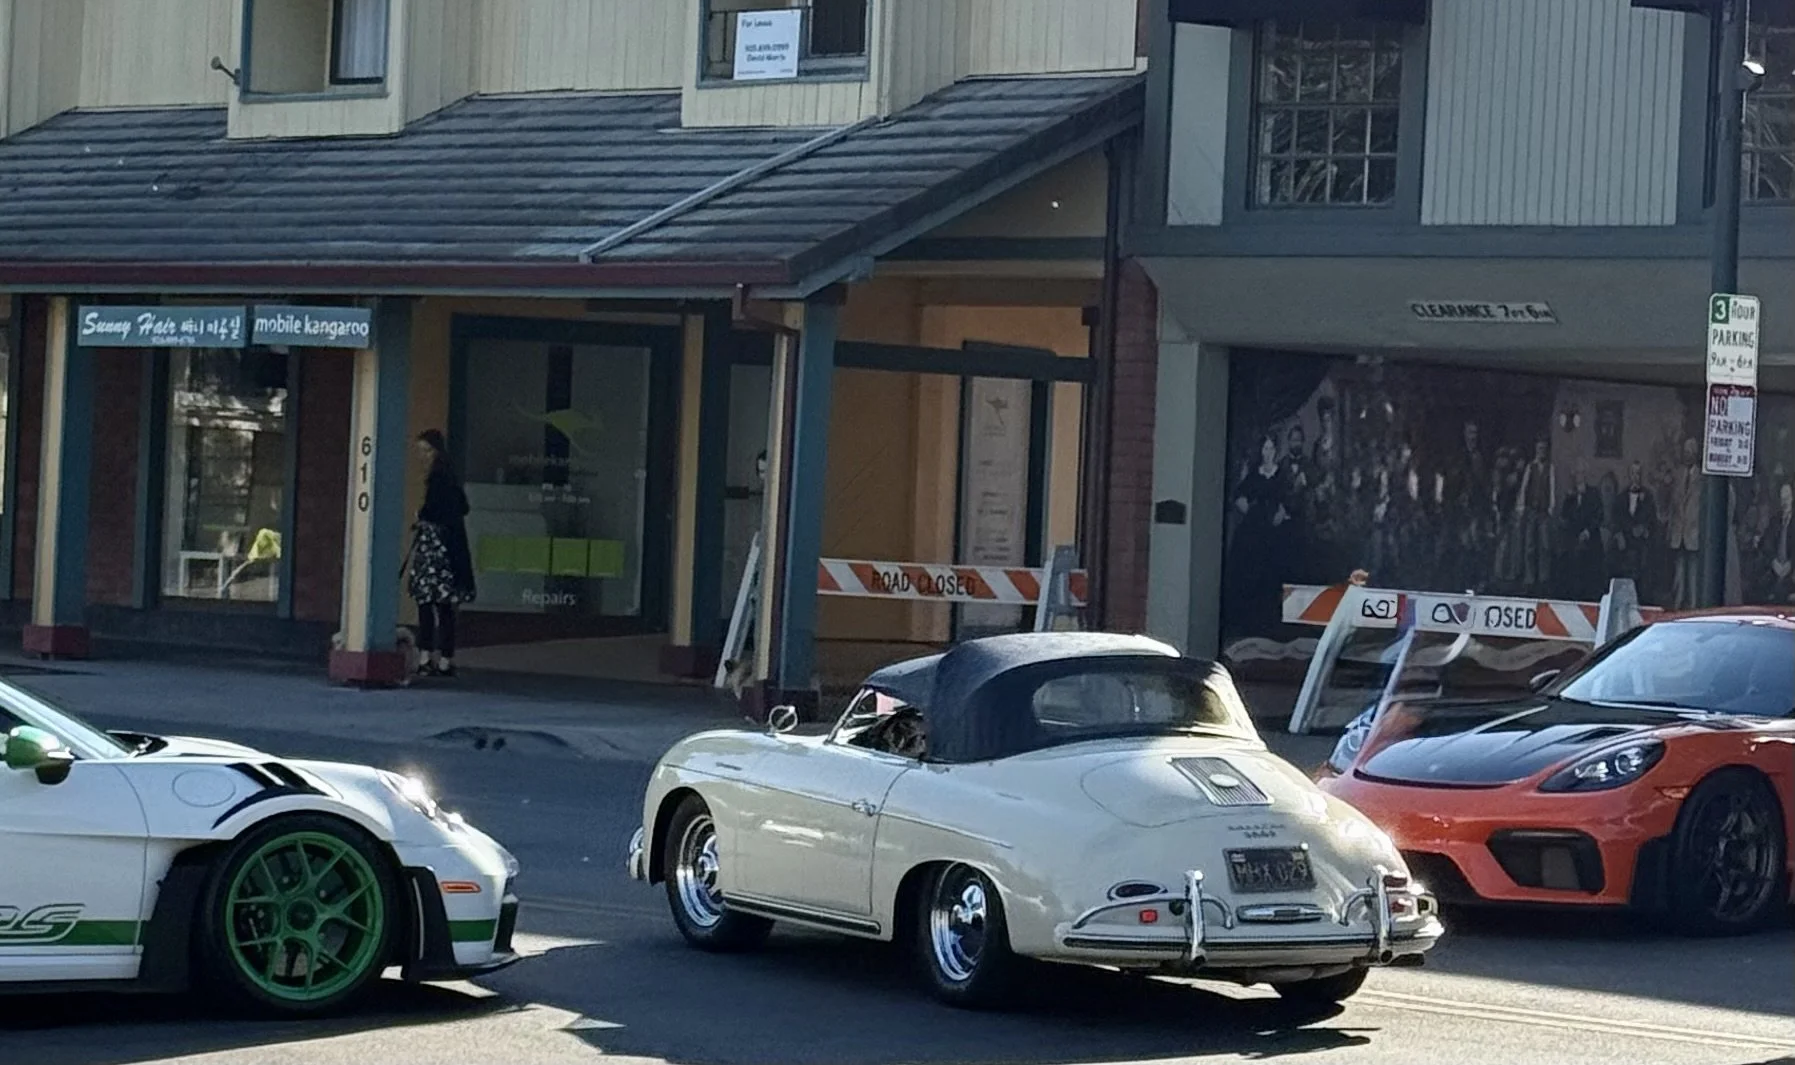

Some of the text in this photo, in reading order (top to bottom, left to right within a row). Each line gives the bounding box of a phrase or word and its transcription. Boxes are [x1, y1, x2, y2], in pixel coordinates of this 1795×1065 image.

[1410, 303, 1496, 318] CLEARANCE
[1715, 300, 1755, 320] 3 HOUR
[82, 312, 132, 342] Sunny
[137, 312, 177, 336] Hair
[255, 313, 369, 340] mobile kangaroo
[1712, 329, 1755, 349] PARKING
[1711, 395, 1727, 416] NO
[1710, 419, 1751, 436] PARKING
[871, 570, 976, 596] ROAD CLOSED
[522, 588, 577, 608] Repairs
